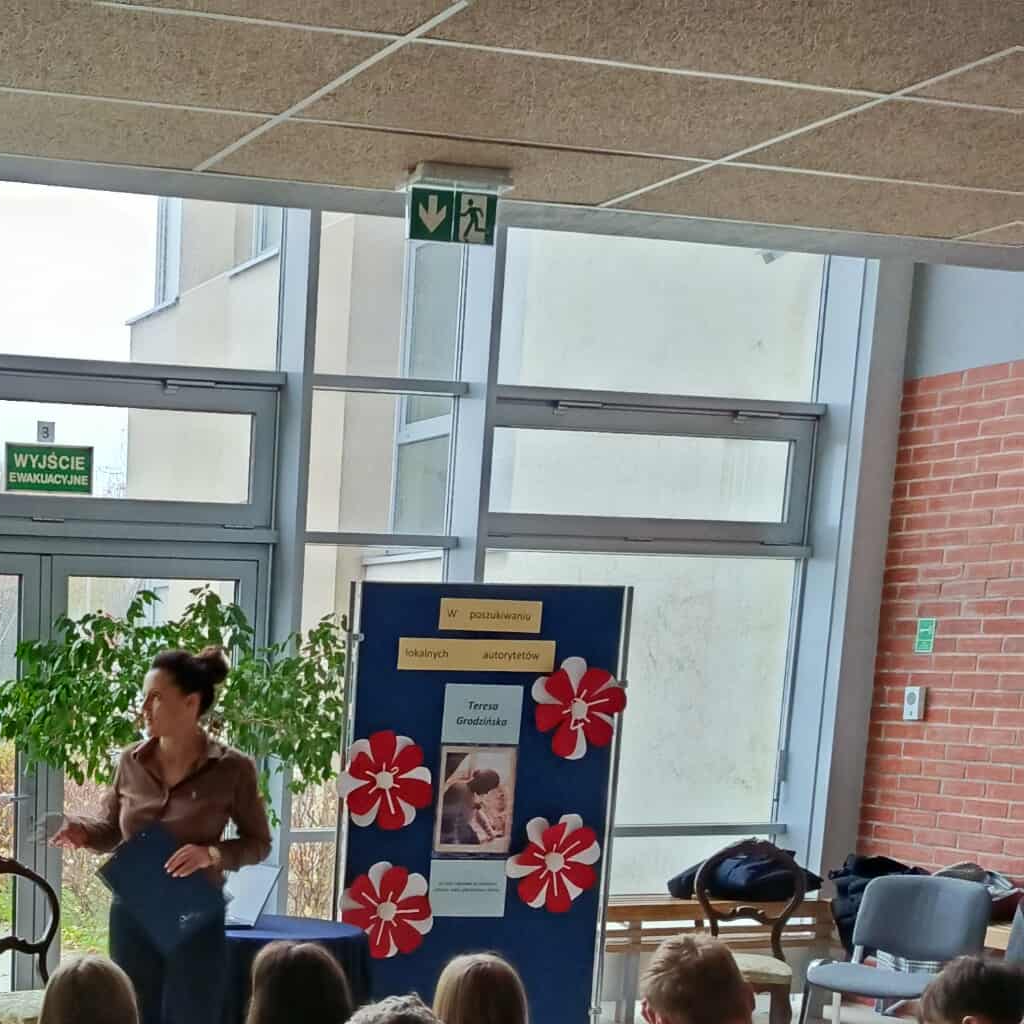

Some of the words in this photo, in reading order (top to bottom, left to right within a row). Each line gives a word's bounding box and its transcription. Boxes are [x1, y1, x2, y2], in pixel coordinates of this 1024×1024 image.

[40, 426, 50, 439] 3
[14, 451, 85, 470] WYJŚCIE
[9, 471, 88, 486] EWAKUACYJNE
[447, 609, 458, 618] W
[469, 610, 531, 622] poszukiwaniu
[405, 647, 449, 660] lokalnych
[482, 650, 540, 662] autorytetów
[468, 701, 499, 711] Teresa
[456, 716, 508, 728] Grodzińska
